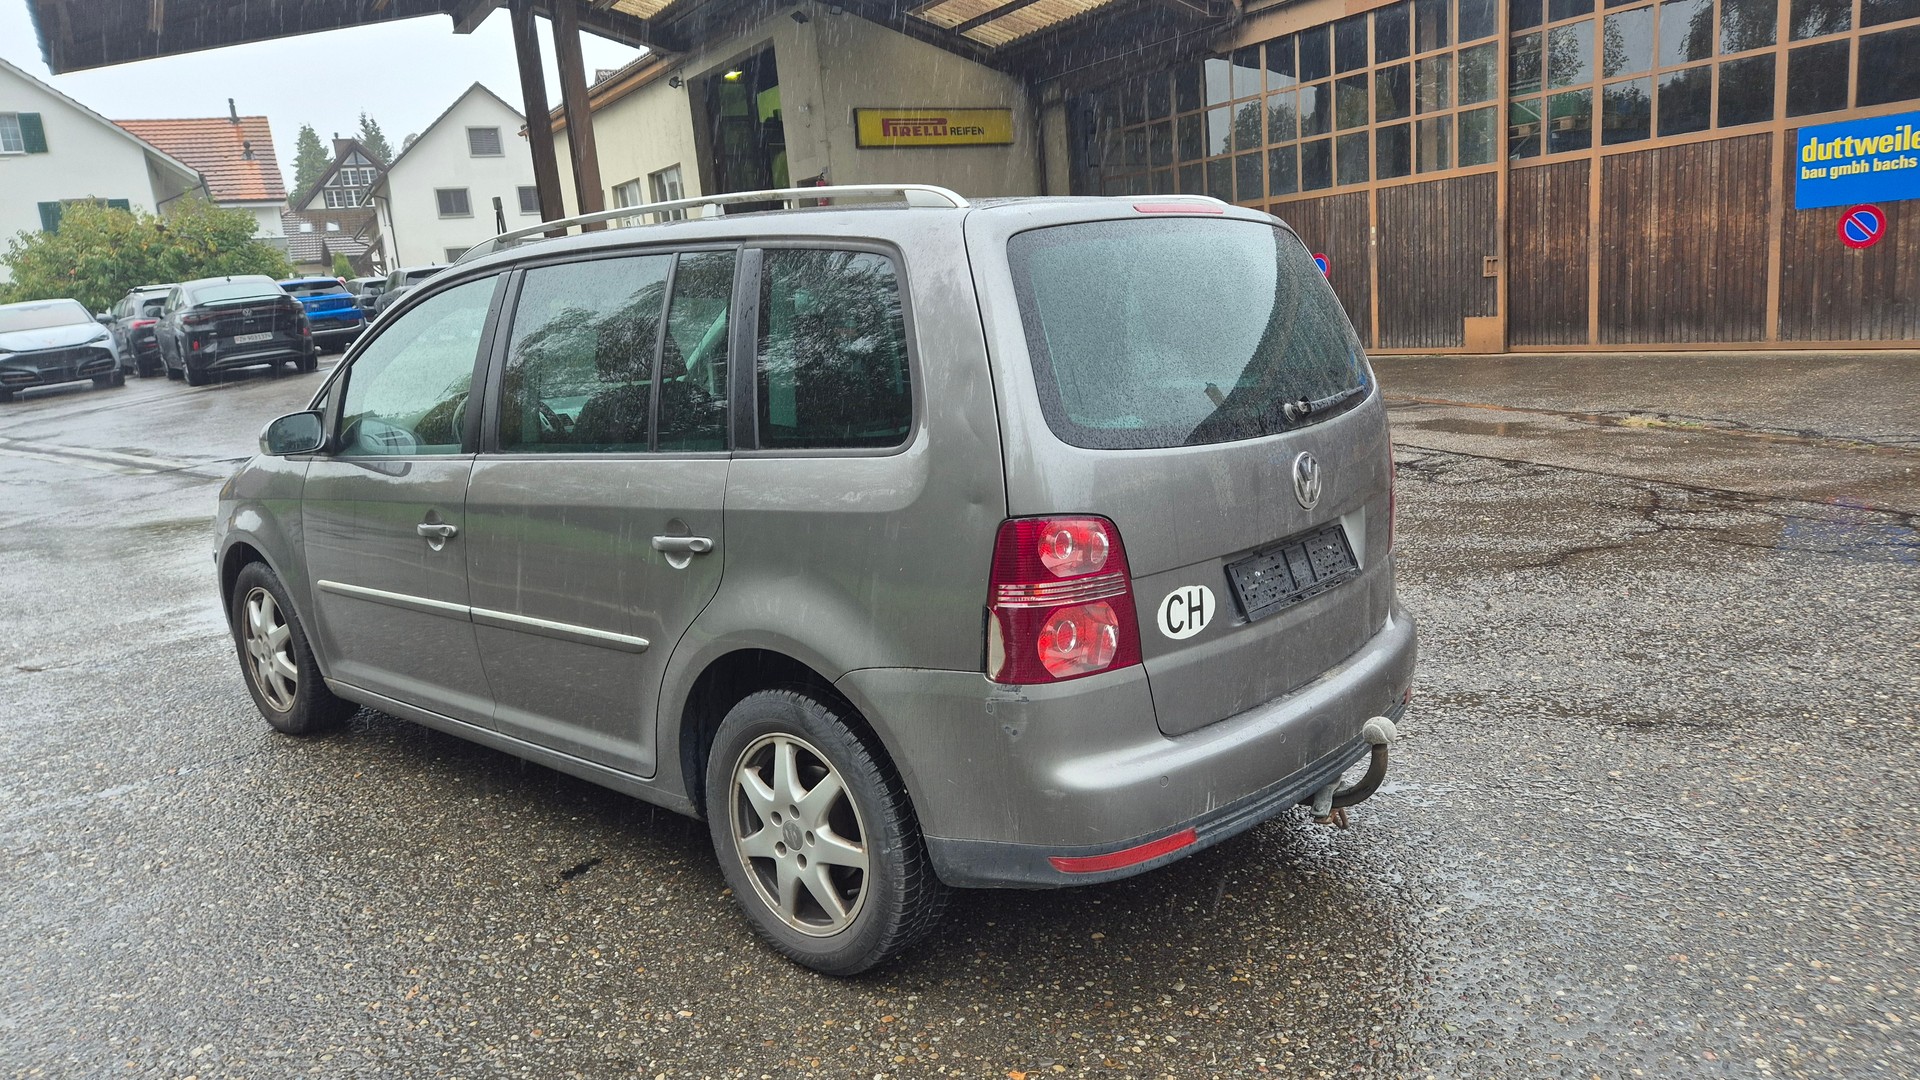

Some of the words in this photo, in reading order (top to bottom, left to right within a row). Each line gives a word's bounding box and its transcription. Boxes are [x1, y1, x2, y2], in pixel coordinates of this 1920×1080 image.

[882, 118, 948, 137] PIRELLI
[950, 126, 985, 136] REIFEN
[1801, 166, 1827, 180] bau
[1830, 159, 1870, 180] gmbh
[1873, 155, 1918, 172] bachs
[1166, 587, 1204, 633] CH
